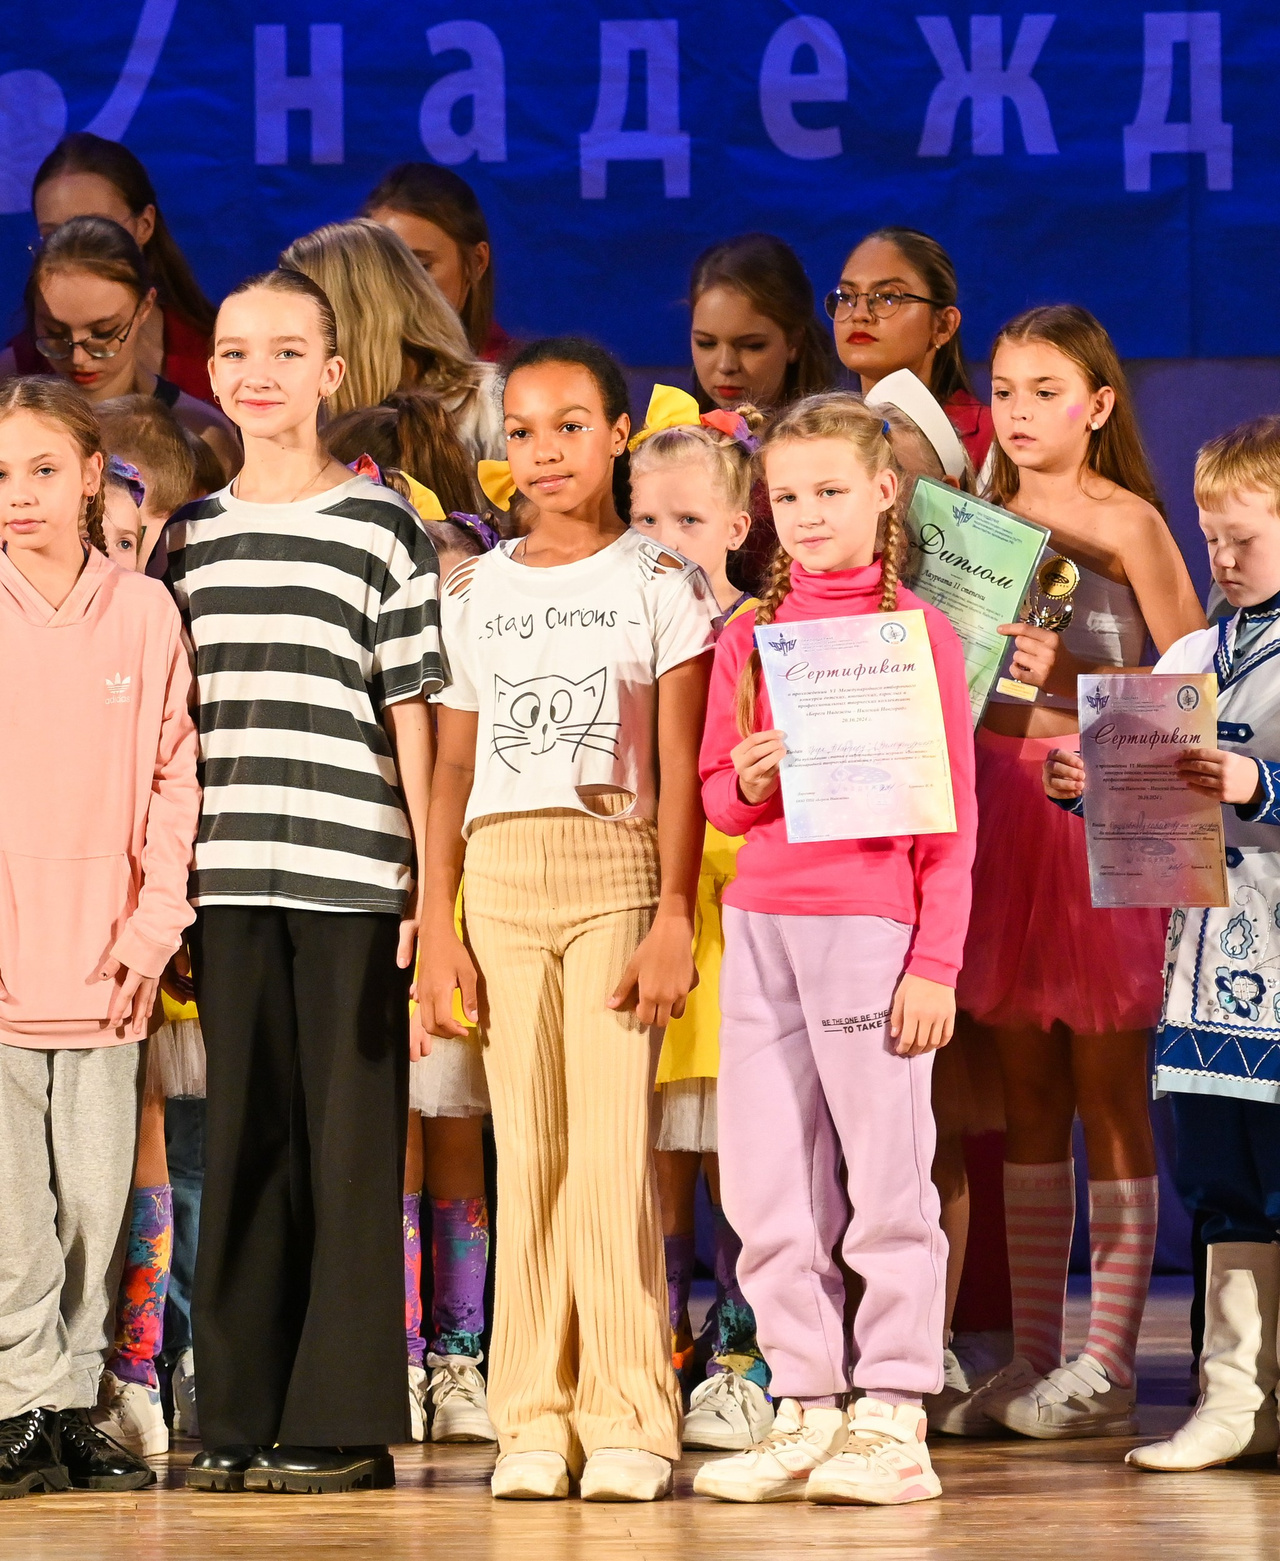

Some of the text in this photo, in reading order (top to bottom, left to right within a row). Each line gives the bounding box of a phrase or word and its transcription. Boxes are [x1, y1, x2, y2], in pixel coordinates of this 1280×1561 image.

[910, 523, 1014, 590] Диплом
[485, 606, 618, 639] stay Curious
[777, 658, 917, 684] Сертификат
[1089, 723, 1202, 750] Сертификат
[832, 1018, 844, 1026] THE
[844, 1016, 859, 1025] ONE
[860, 1013, 871, 1022] BE
[873, 1009, 889, 1019] THE
[843, 1020, 883, 1034] TO TAKE
